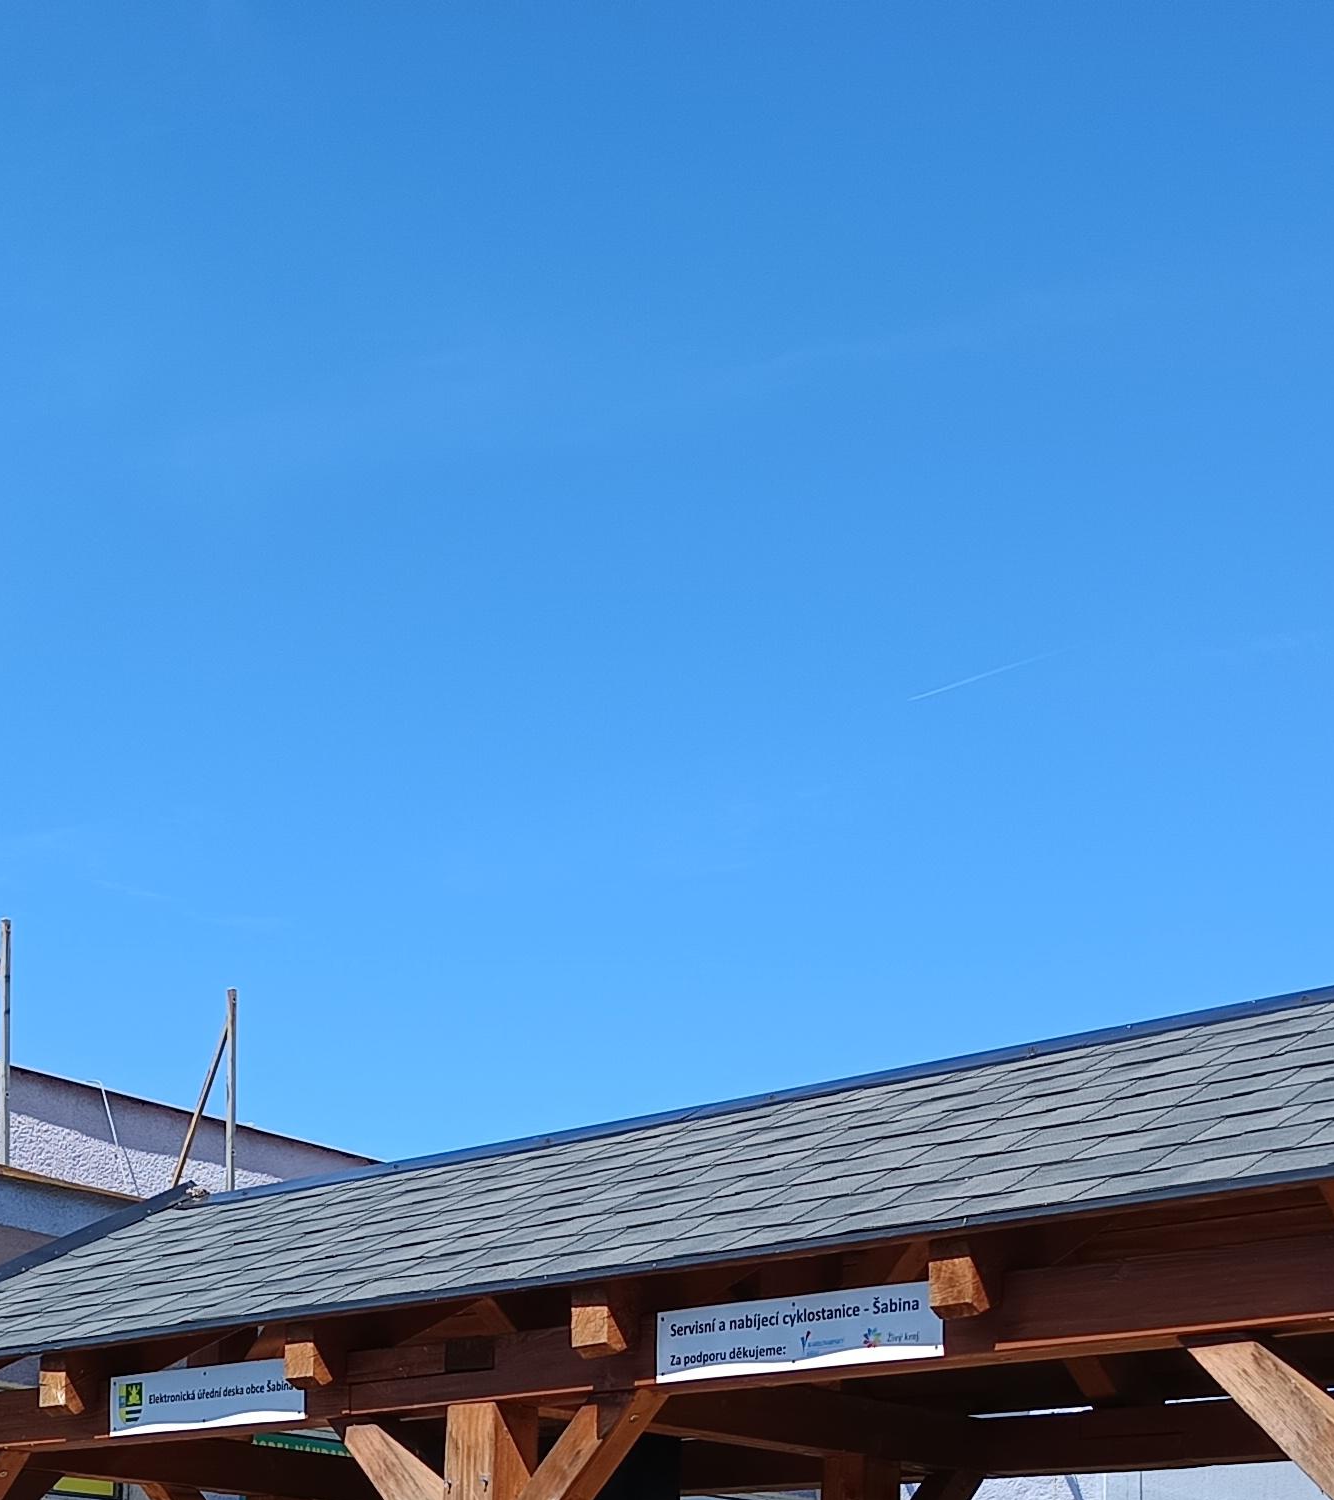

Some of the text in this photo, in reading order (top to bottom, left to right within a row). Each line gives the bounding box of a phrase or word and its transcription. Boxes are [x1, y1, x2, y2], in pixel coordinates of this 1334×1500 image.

[670, 1318, 716, 1337] Servisní
[718, 1320, 726, 1331] a
[729, 1311, 779, 1331] nabíjecí
[782, 1303, 860, 1327] cyklostanice
[872, 1297, 920, 1315] Šabina
[670, 1355, 682, 1366] Za
[684, 1350, 727, 1368] podporu
[729, 1344, 787, 1360] děkujeme:
[148, 1391, 196, 1405] Elektronická
[197, 1386, 222, 1400] úřední
[222, 1385, 244, 1397] deska
[246, 1383, 265, 1396] obce
